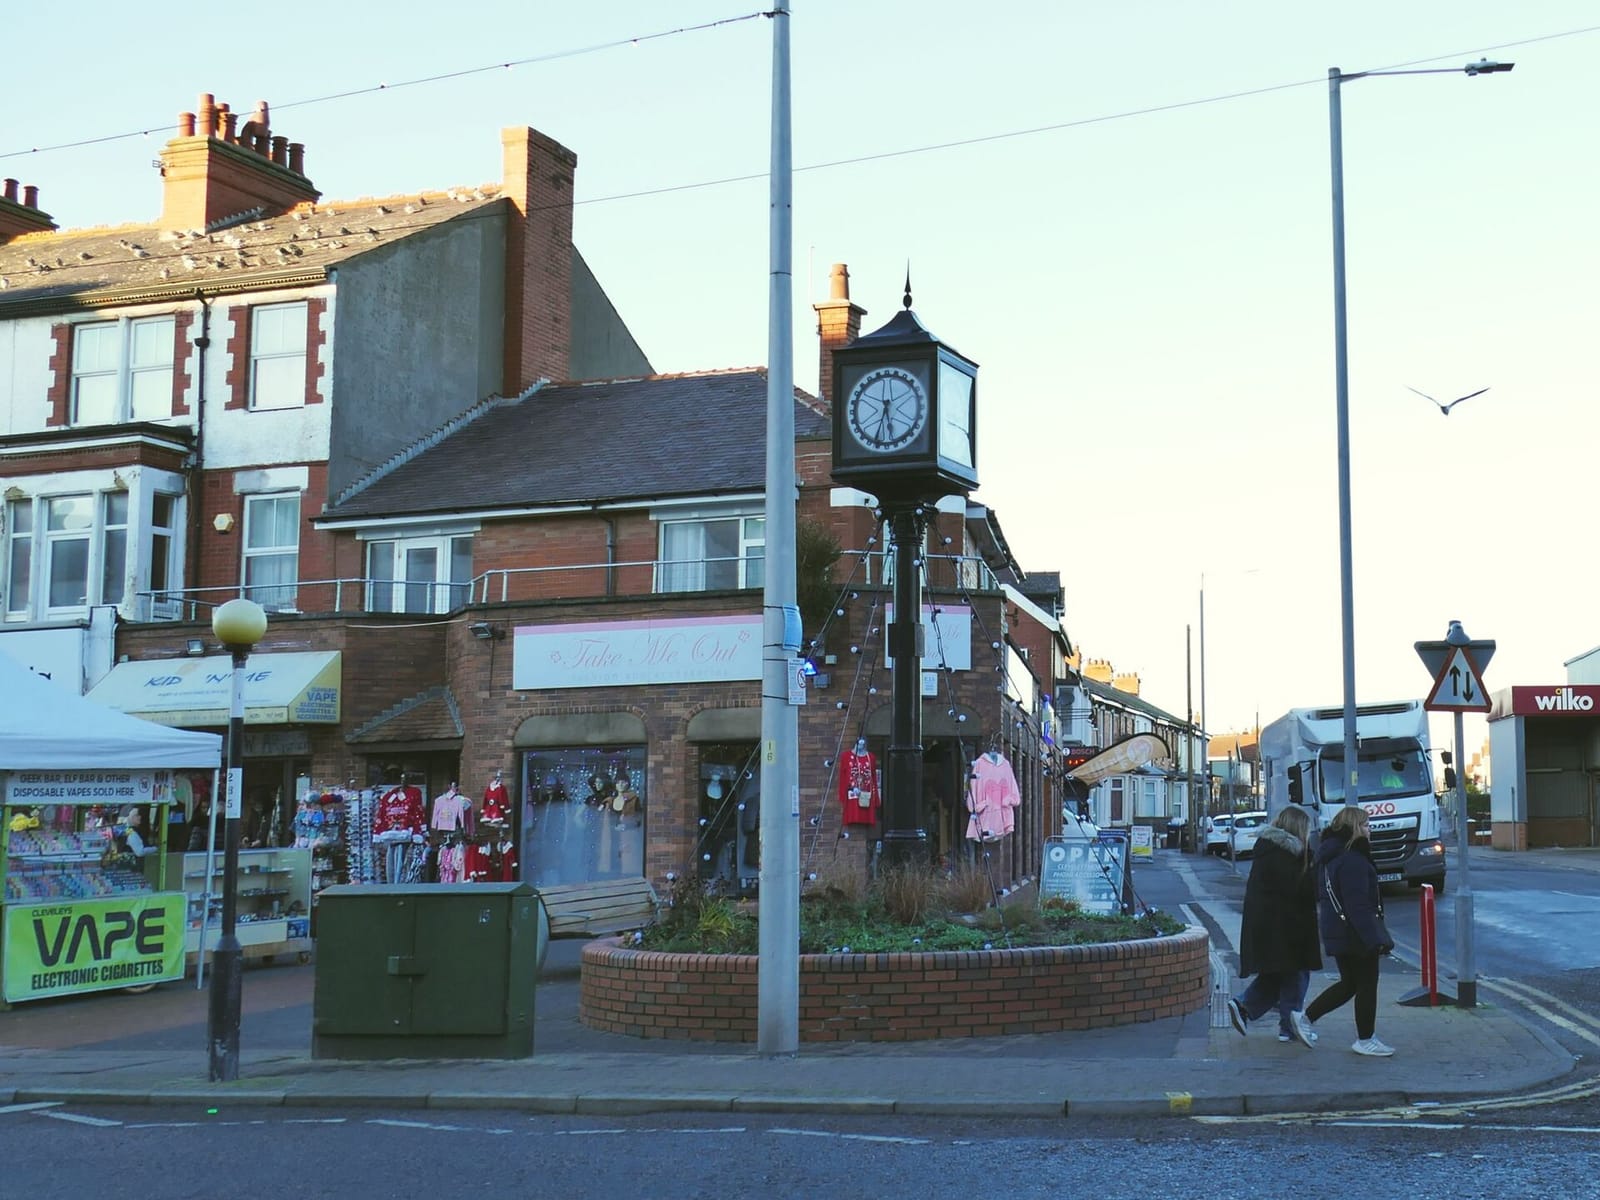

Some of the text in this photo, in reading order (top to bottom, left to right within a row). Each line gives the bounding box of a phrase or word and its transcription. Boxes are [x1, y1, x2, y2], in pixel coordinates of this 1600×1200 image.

[564, 632, 738, 668] Take Me Out
[144, 676, 182, 687] KID
[307, 692, 336, 702] VAPE
[1535, 688, 1593, 710] wilko
[20, 774, 41, 783] GEEK
[64, 774, 78, 783] ELF
[79, 774, 95, 783] BAR
[105, 773, 130, 783] OTHER
[13, 787, 134, 797] DISPOSABLE VAPES SOLD HERE
[1364, 803, 1395, 816] GXO
[1369, 822, 1395, 830] DAF
[1050, 846, 1120, 862] OPEN
[32, 907, 72, 917] CLEVELEYS
[33, 908, 165, 967] VAPE
[31, 960, 163, 990] ELECTRONIC CIGARETTES
